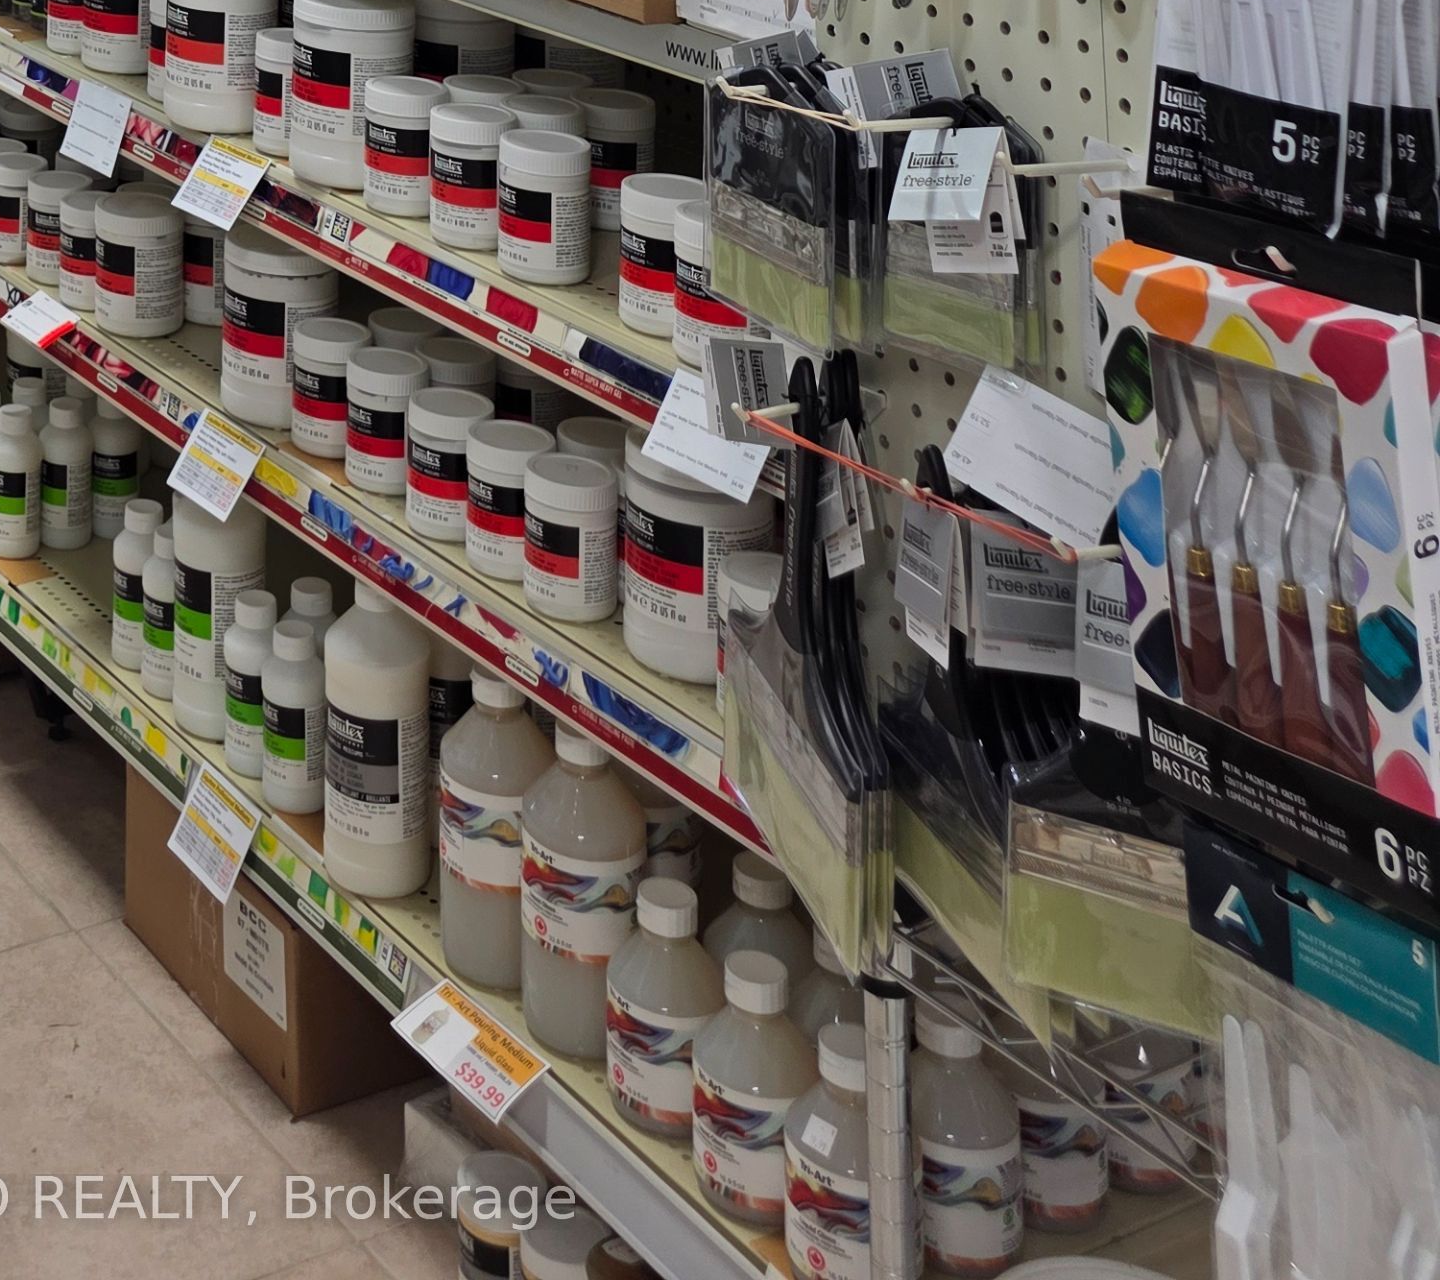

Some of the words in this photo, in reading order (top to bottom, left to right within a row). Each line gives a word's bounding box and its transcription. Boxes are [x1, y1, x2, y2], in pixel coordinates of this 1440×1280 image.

[905, 61, 934, 107] Liquit
[1271, 118, 1298, 164] 5
[1301, 134, 1321, 151] PC
[1347, 144, 1365, 160] PZ
[1348, 130, 1366, 145] PC
[1397, 133, 1416, 149] PC
[906, 151, 960, 169] Liquitex
[1301, 149, 1320, 165] PZ
[1398, 148, 1417, 164] PZ
[983, 542, 1043, 574] Liquitex
[1413, 533, 1440, 560] 6
[1085, 588, 1129, 623] Liqui
[1147, 716, 1210, 773] Liquitex
[1151, 749, 1213, 796] BASICS
[1373, 826, 1402, 881] 6
[1405, 845, 1430, 868] PC
[1406, 865, 1432, 892] PZ
[239, 899, 267, 934] BCC
[1411, 938, 1426, 967] 5
[455, 999, 471, 1018] Art
[470, 1011, 500, 1042] Pouring
[500, 1038, 534, 1070] Medium
[474, 1036, 496, 1058] Liquid
[454, 1061, 505, 1108] $39.99
[799, 1158, 834, 1188] Tri-Art
